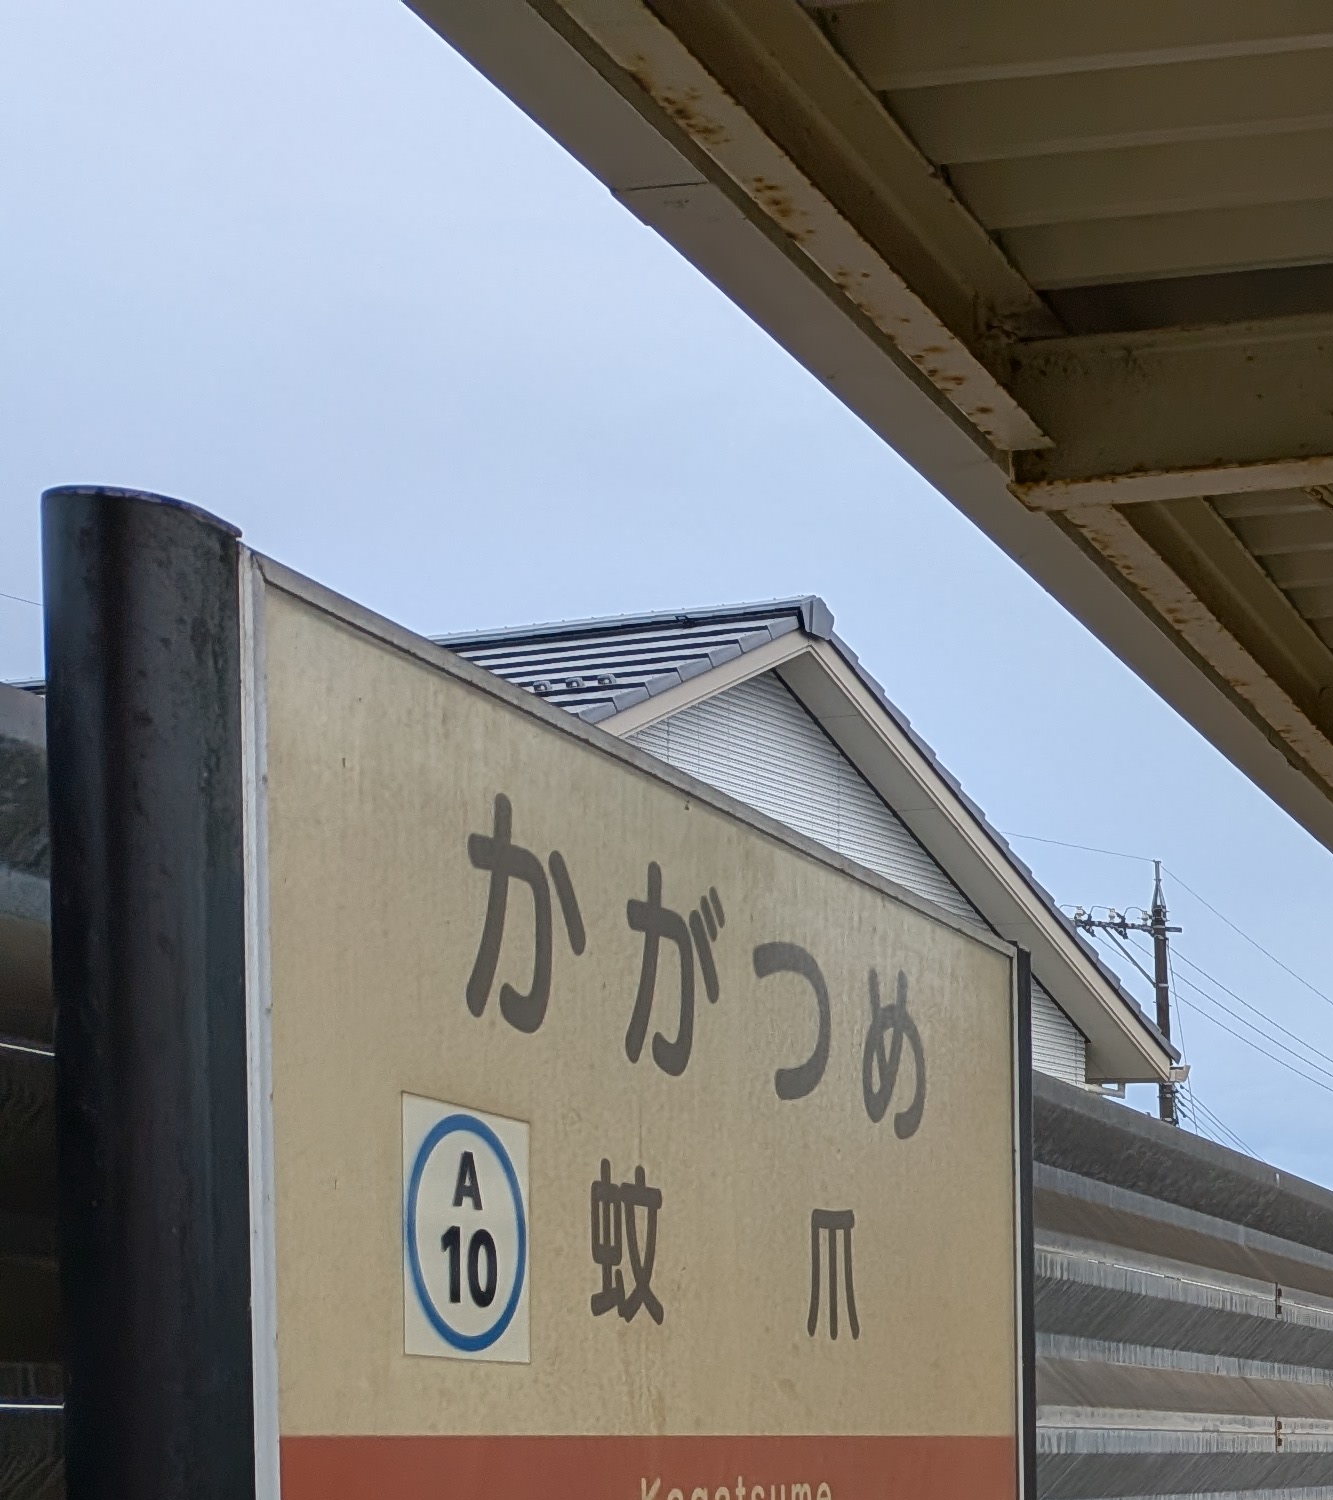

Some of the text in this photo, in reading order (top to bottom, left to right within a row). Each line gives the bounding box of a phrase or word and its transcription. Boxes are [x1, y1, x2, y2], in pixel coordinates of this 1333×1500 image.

[465, 792, 926, 1141] かがつめ
[452, 1150, 483, 1211] A
[440, 1224, 498, 1309] 10
